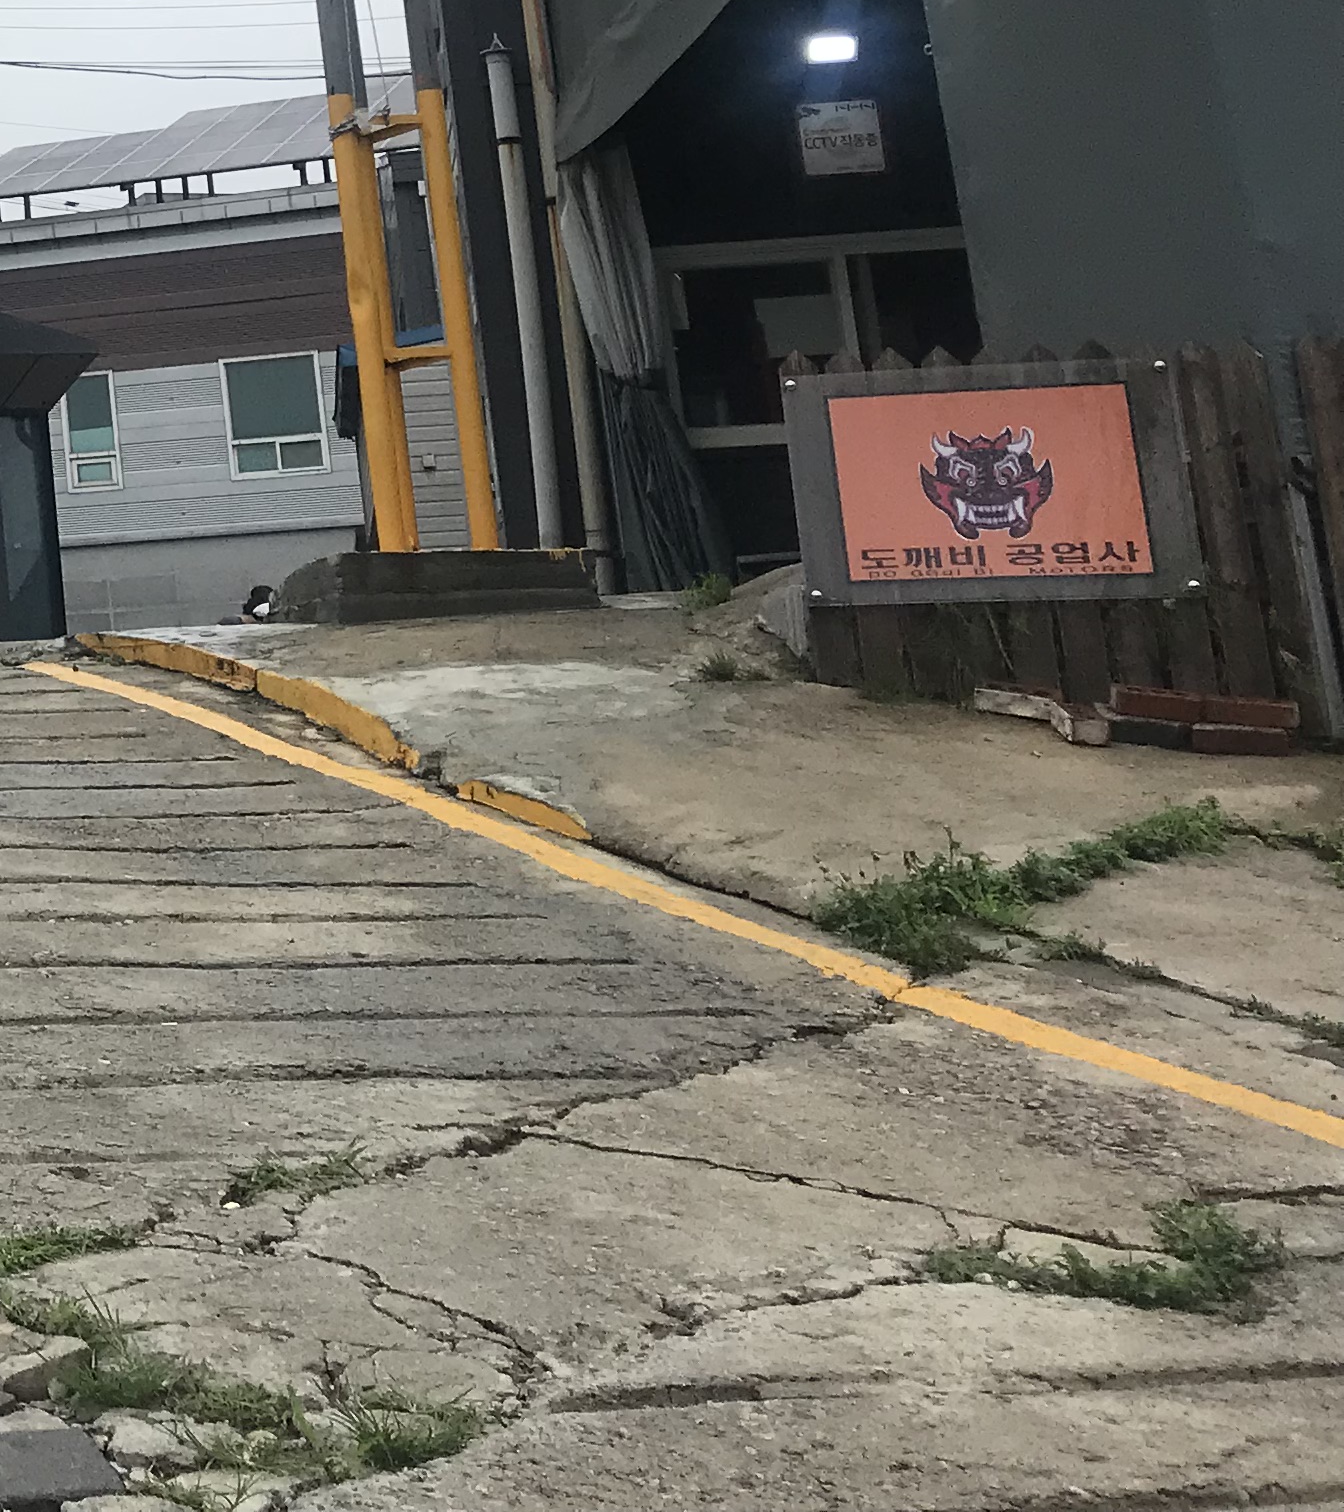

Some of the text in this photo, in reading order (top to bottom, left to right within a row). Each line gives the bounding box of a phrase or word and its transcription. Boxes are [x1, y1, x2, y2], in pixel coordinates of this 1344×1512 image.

[804, 135, 838, 150] CCTV
[861, 540, 1141, 570] 도깨비 공업사
[1029, 564, 1133, 575] MOTORS
